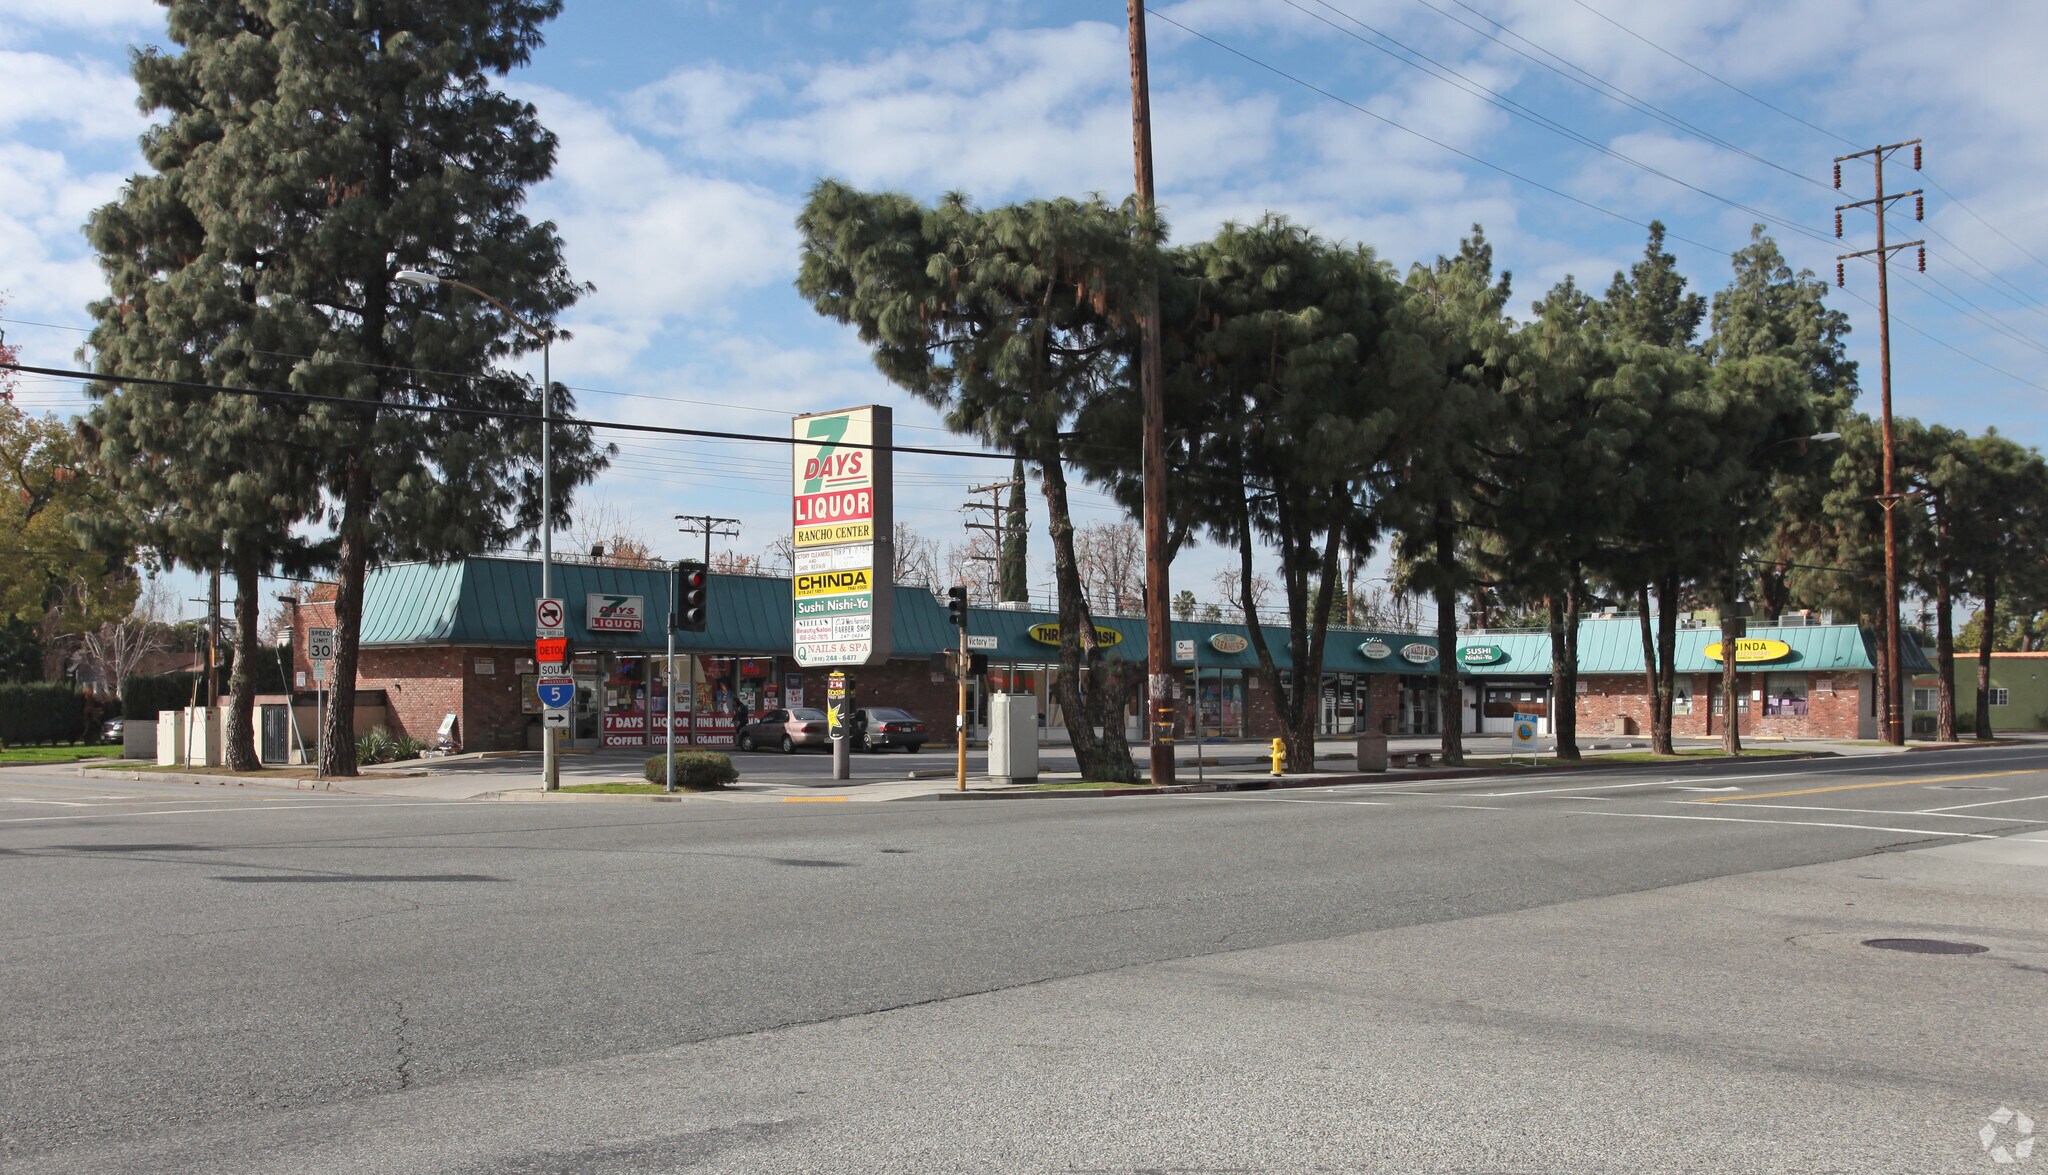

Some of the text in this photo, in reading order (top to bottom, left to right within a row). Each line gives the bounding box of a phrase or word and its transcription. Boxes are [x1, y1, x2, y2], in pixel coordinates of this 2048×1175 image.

[803, 415, 850, 494] 7
[804, 451, 863, 480] DAYS
[796, 492, 869, 520] LIQUOR
[798, 525, 869, 542] RANCHO CENTER
[811, 550, 831, 558] CLEANERS
[798, 571, 867, 590] CHINDA
[599, 596, 629, 617] 7
[599, 606, 635, 614] DAYS
[798, 597, 868, 613] Sushi Nishi-Ya
[592, 619, 640, 628] LIQUOR
[834, 624, 870, 634] BARBER SHOP
[968, 637, 987, 647] Victory
[1214, 638, 1245, 650] CLEANERS
[1735, 642, 1767, 651] INDA
[311, 645, 331, 657] 30
[540, 646, 565, 655] DETOU
[797, 642, 869, 661] Q NAILS & SPA
[1466, 647, 1491, 655] SUSHI
[551, 687, 560, 702] 5
[606, 717, 644, 728] 7 DAYS
[652, 717, 689, 728] LIQOR
[696, 717, 713, 727] FINE
[606, 736, 643, 746] COFFEE
[696, 735, 734, 744] CIGARETTES
